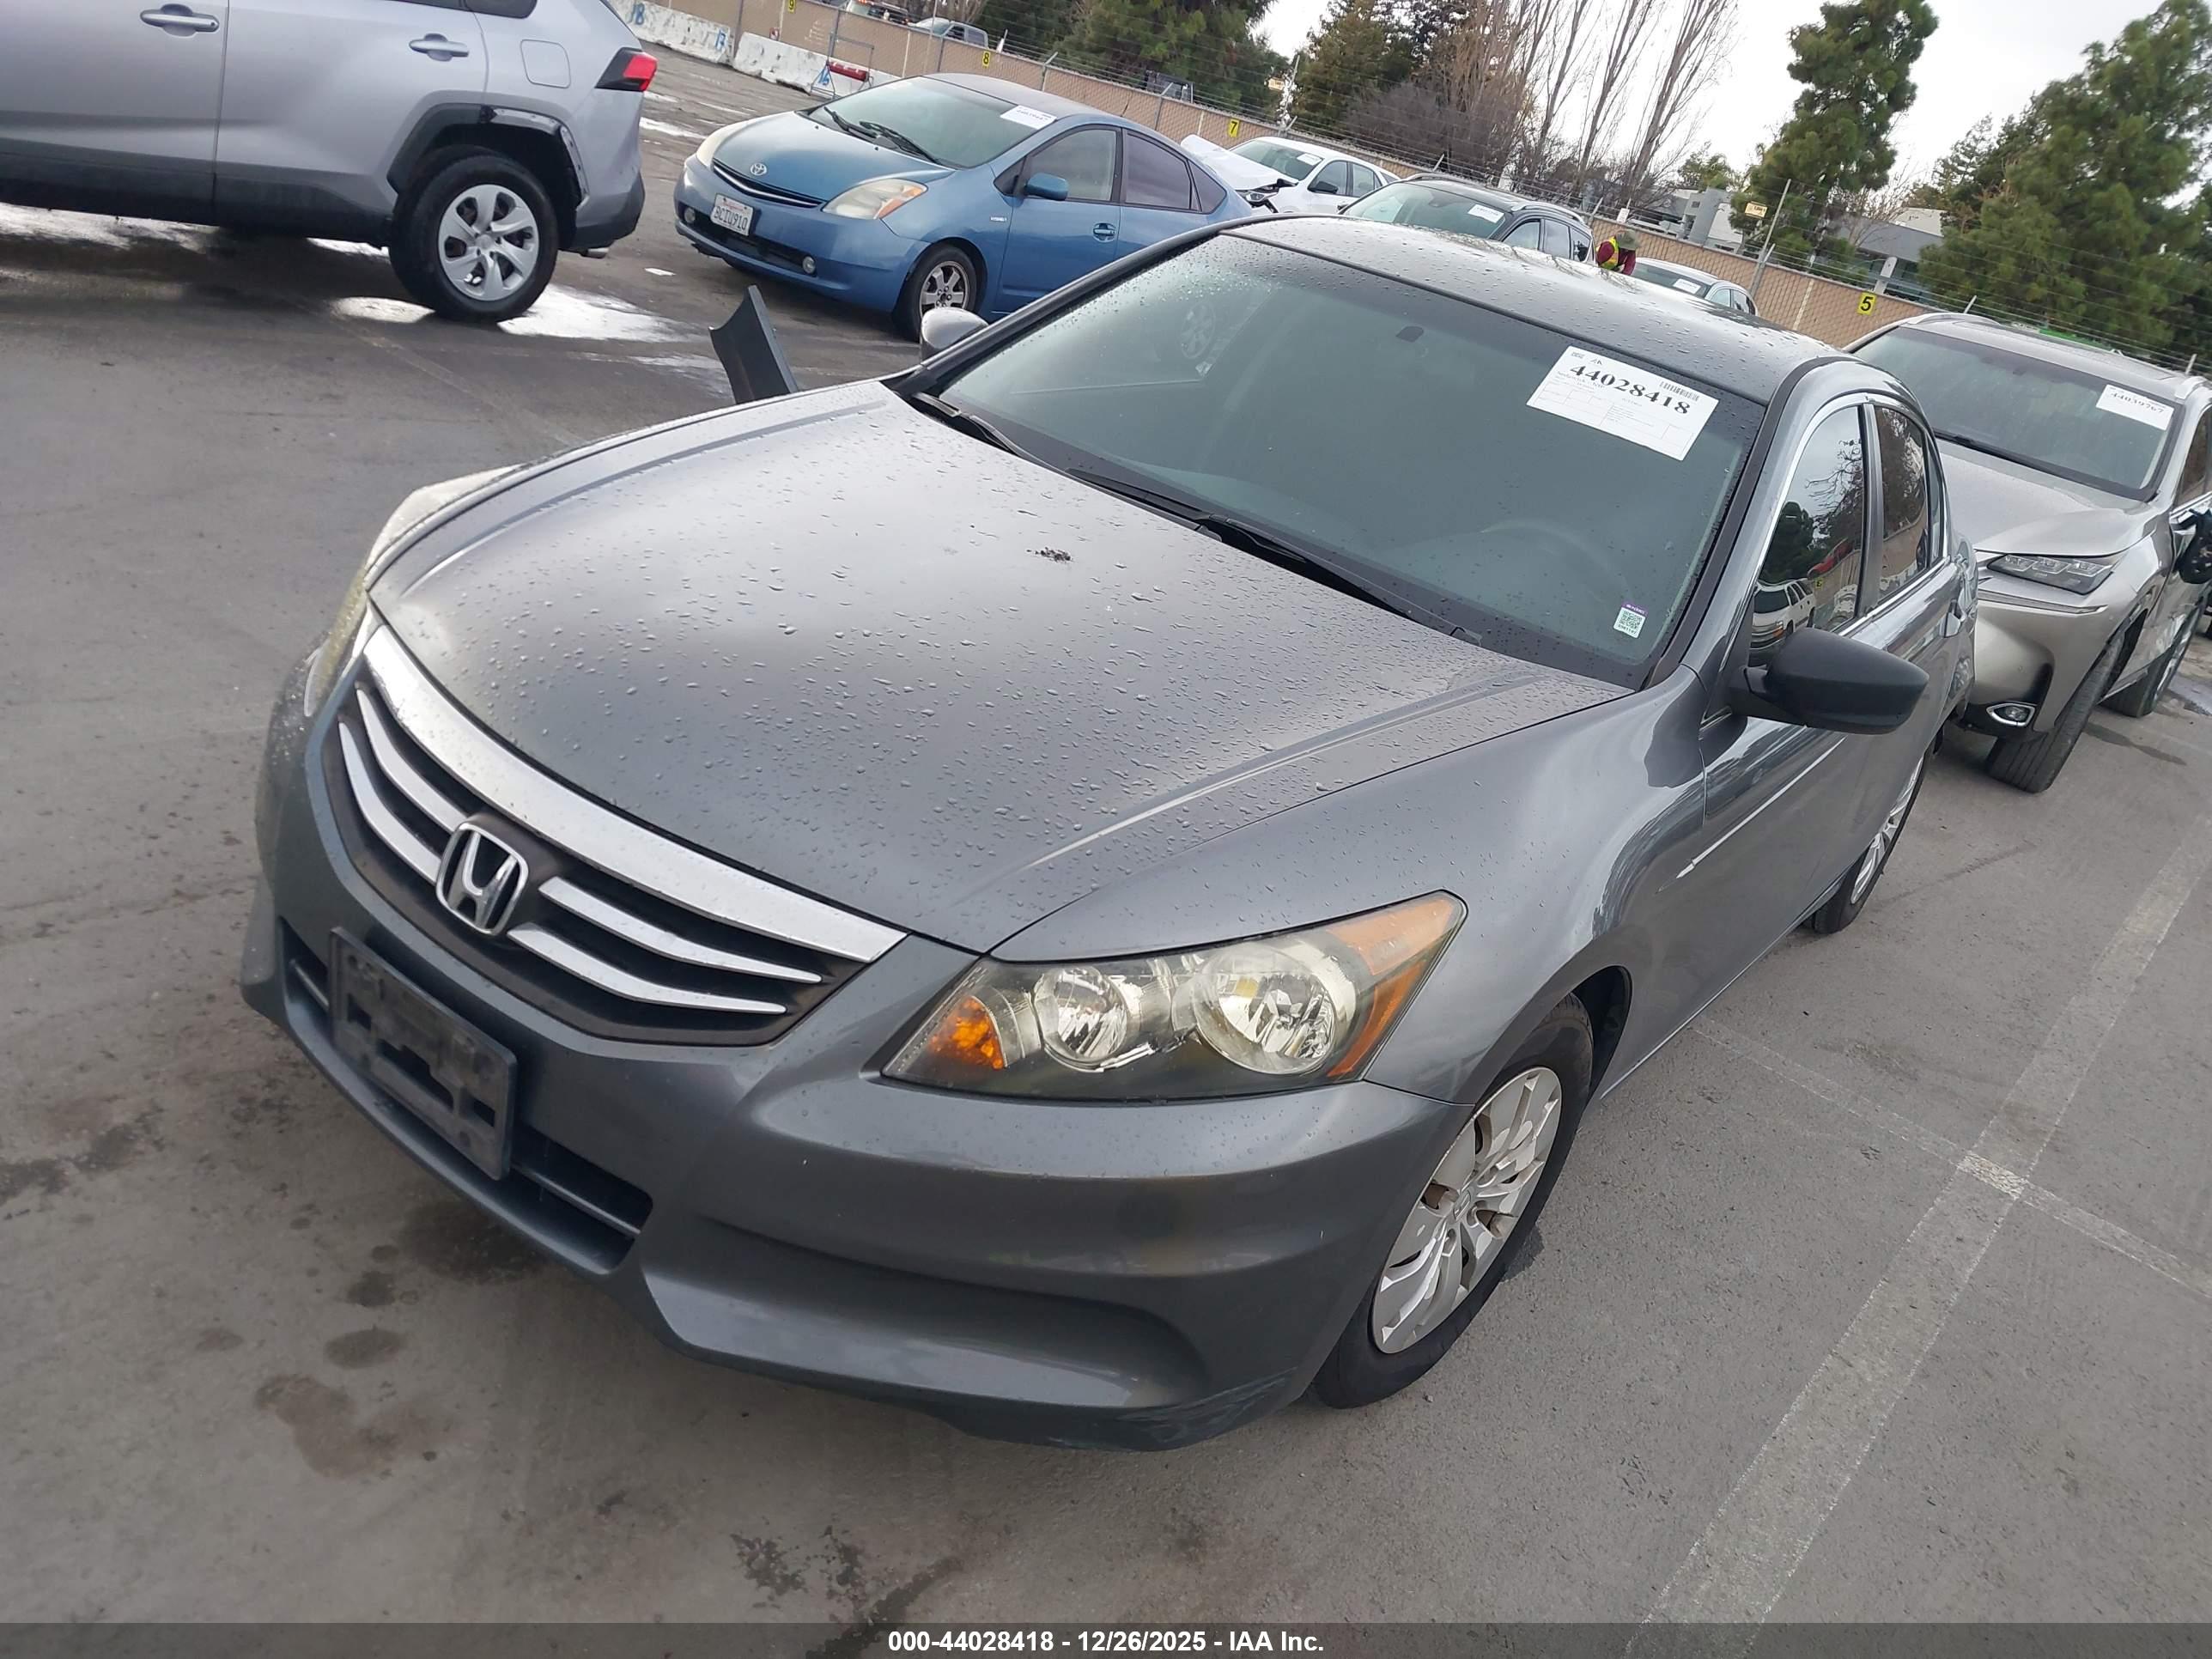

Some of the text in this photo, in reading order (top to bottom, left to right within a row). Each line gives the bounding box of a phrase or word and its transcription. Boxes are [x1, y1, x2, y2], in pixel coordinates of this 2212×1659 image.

[982, 52, 990, 65] 8
[1231, 120, 1238, 134] 7
[1860, 295, 1874, 312] 5
[1570, 365, 1691, 415] 44028418
